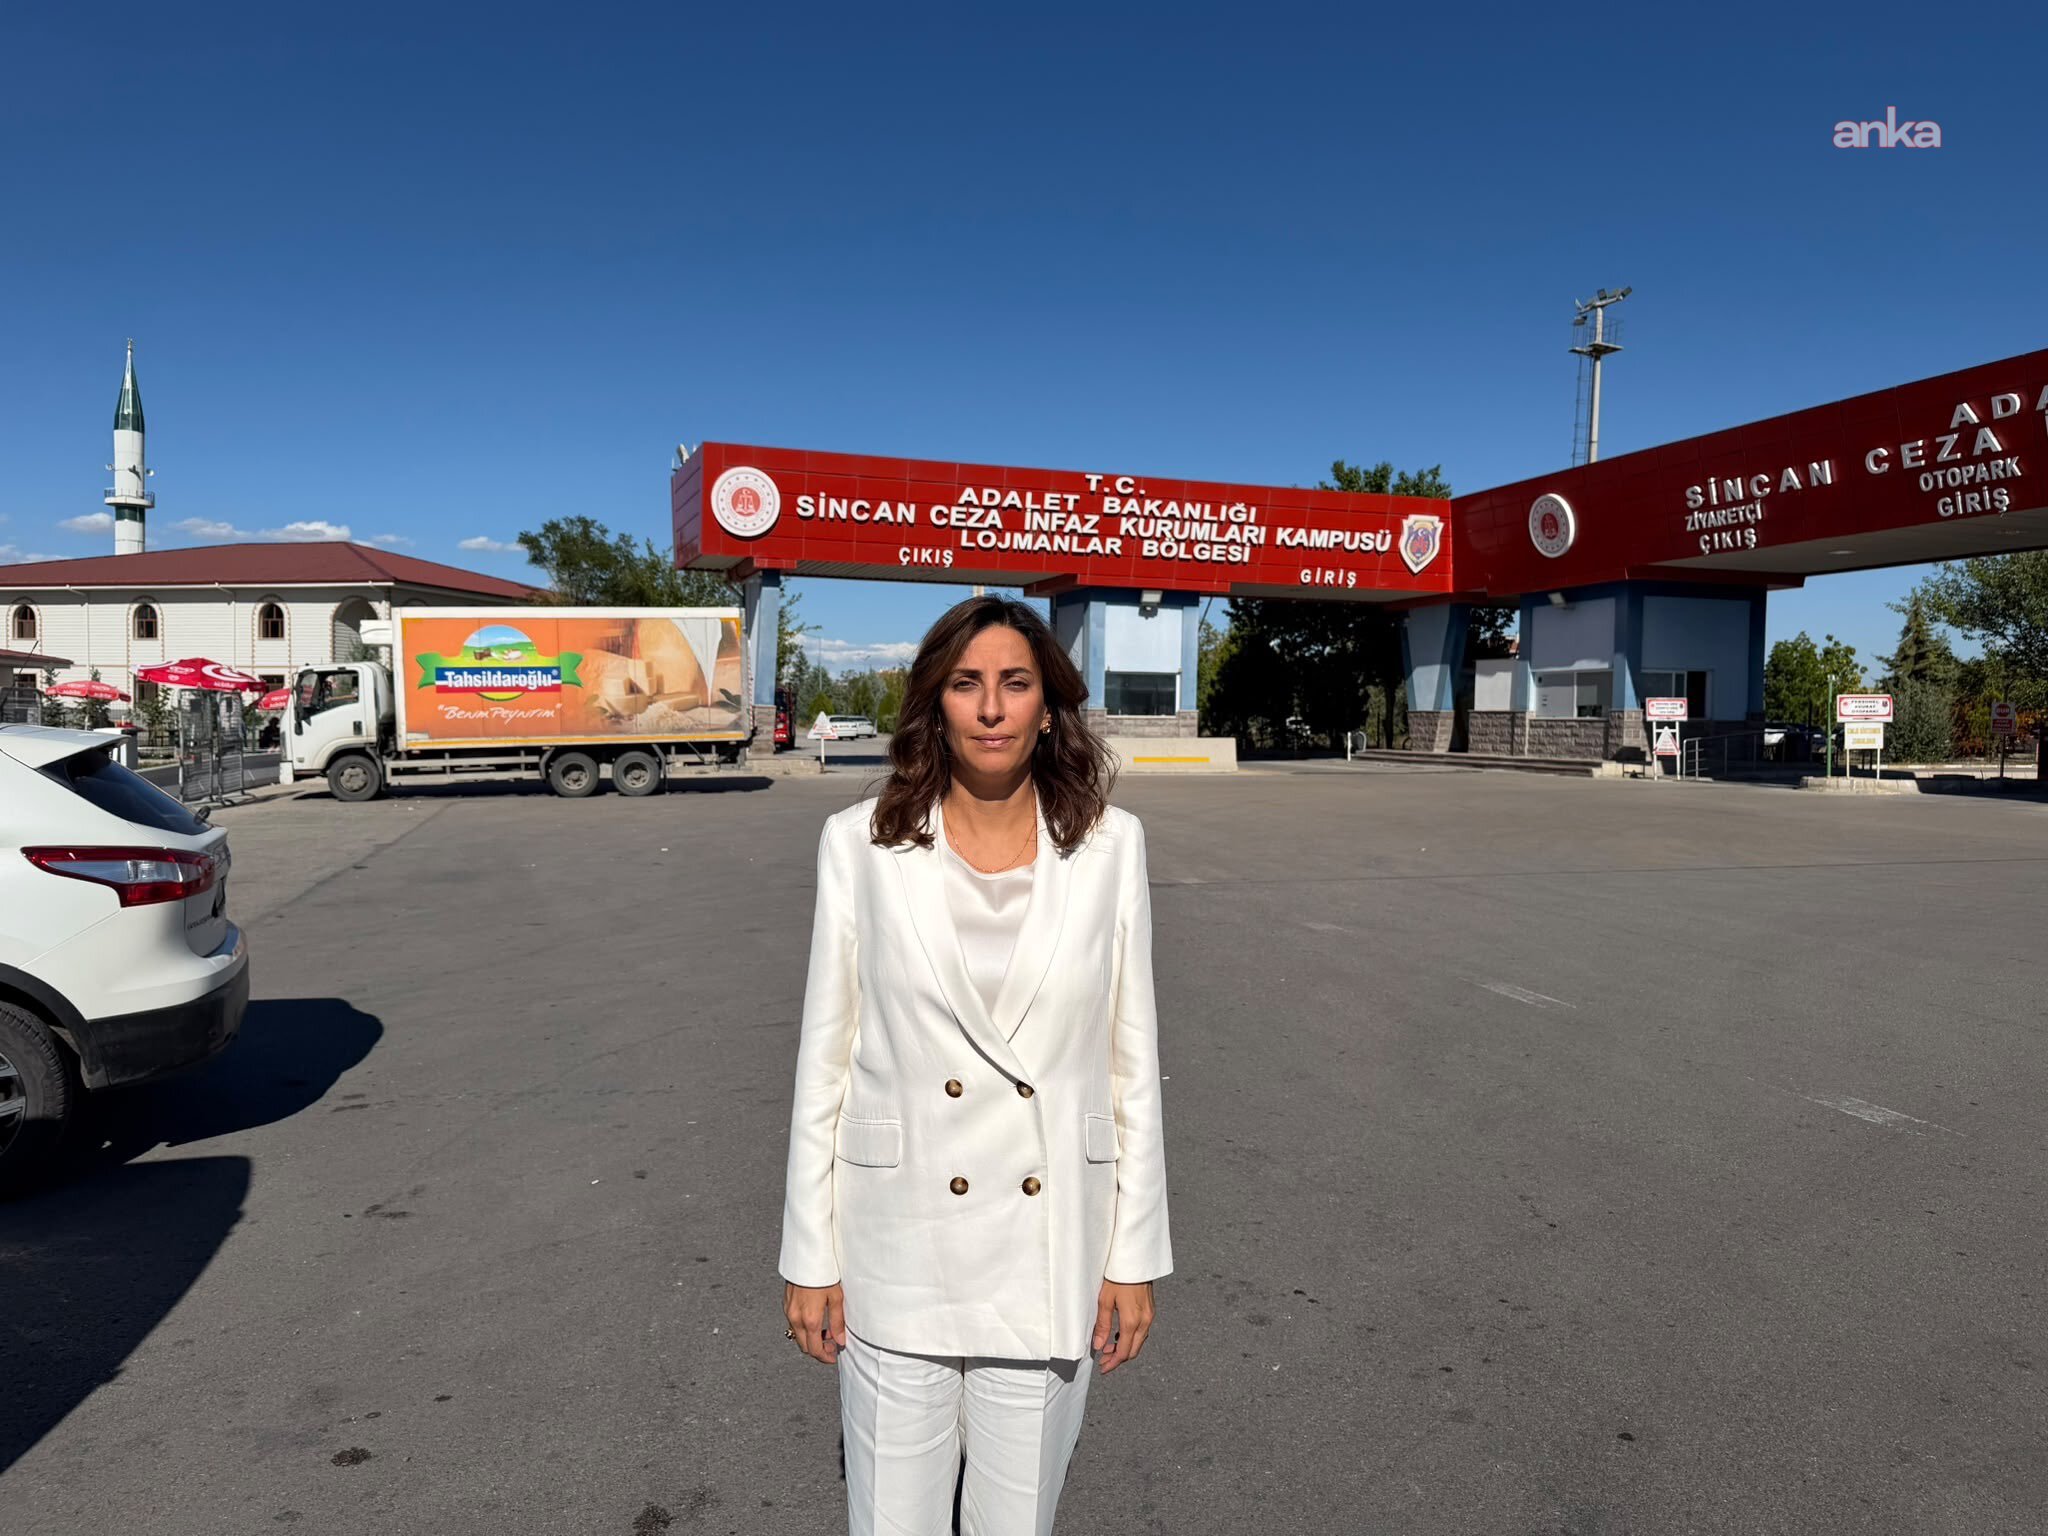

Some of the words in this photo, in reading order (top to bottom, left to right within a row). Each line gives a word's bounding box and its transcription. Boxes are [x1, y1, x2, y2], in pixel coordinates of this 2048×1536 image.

[1085, 473, 1146, 494] T.C.
[1685, 459, 1833, 510] SİNCAN
[1865, 427, 2002, 475] CEZA
[1919, 456, 2022, 492] OTOPARK
[958, 487, 1080, 512] ADALET
[1102, 496, 1257, 523] BAKANLIĞI
[1685, 499, 1764, 531] ZİYARETÇİ
[1937, 485, 2011, 517] GİRİŞ
[796, 492, 916, 524] SİNCAN
[930, 505, 1003, 529] CEZA
[1024, 508, 1099, 534] İNFAZ
[1119, 516, 1266, 545] KURUMLARI
[1276, 527, 1392, 553] KAMPUSÜ
[898, 547, 954, 568] ÇIKIŞ
[961, 530, 1122, 556] LOJMANLAR
[1142, 538, 1251, 563] BÖLGESİ
[1699, 527, 1758, 556] ÇIKIŞ
[1300, 568, 1357, 589] GİRİŞ
[444, 669, 552, 690] Tahsildaroğlu
